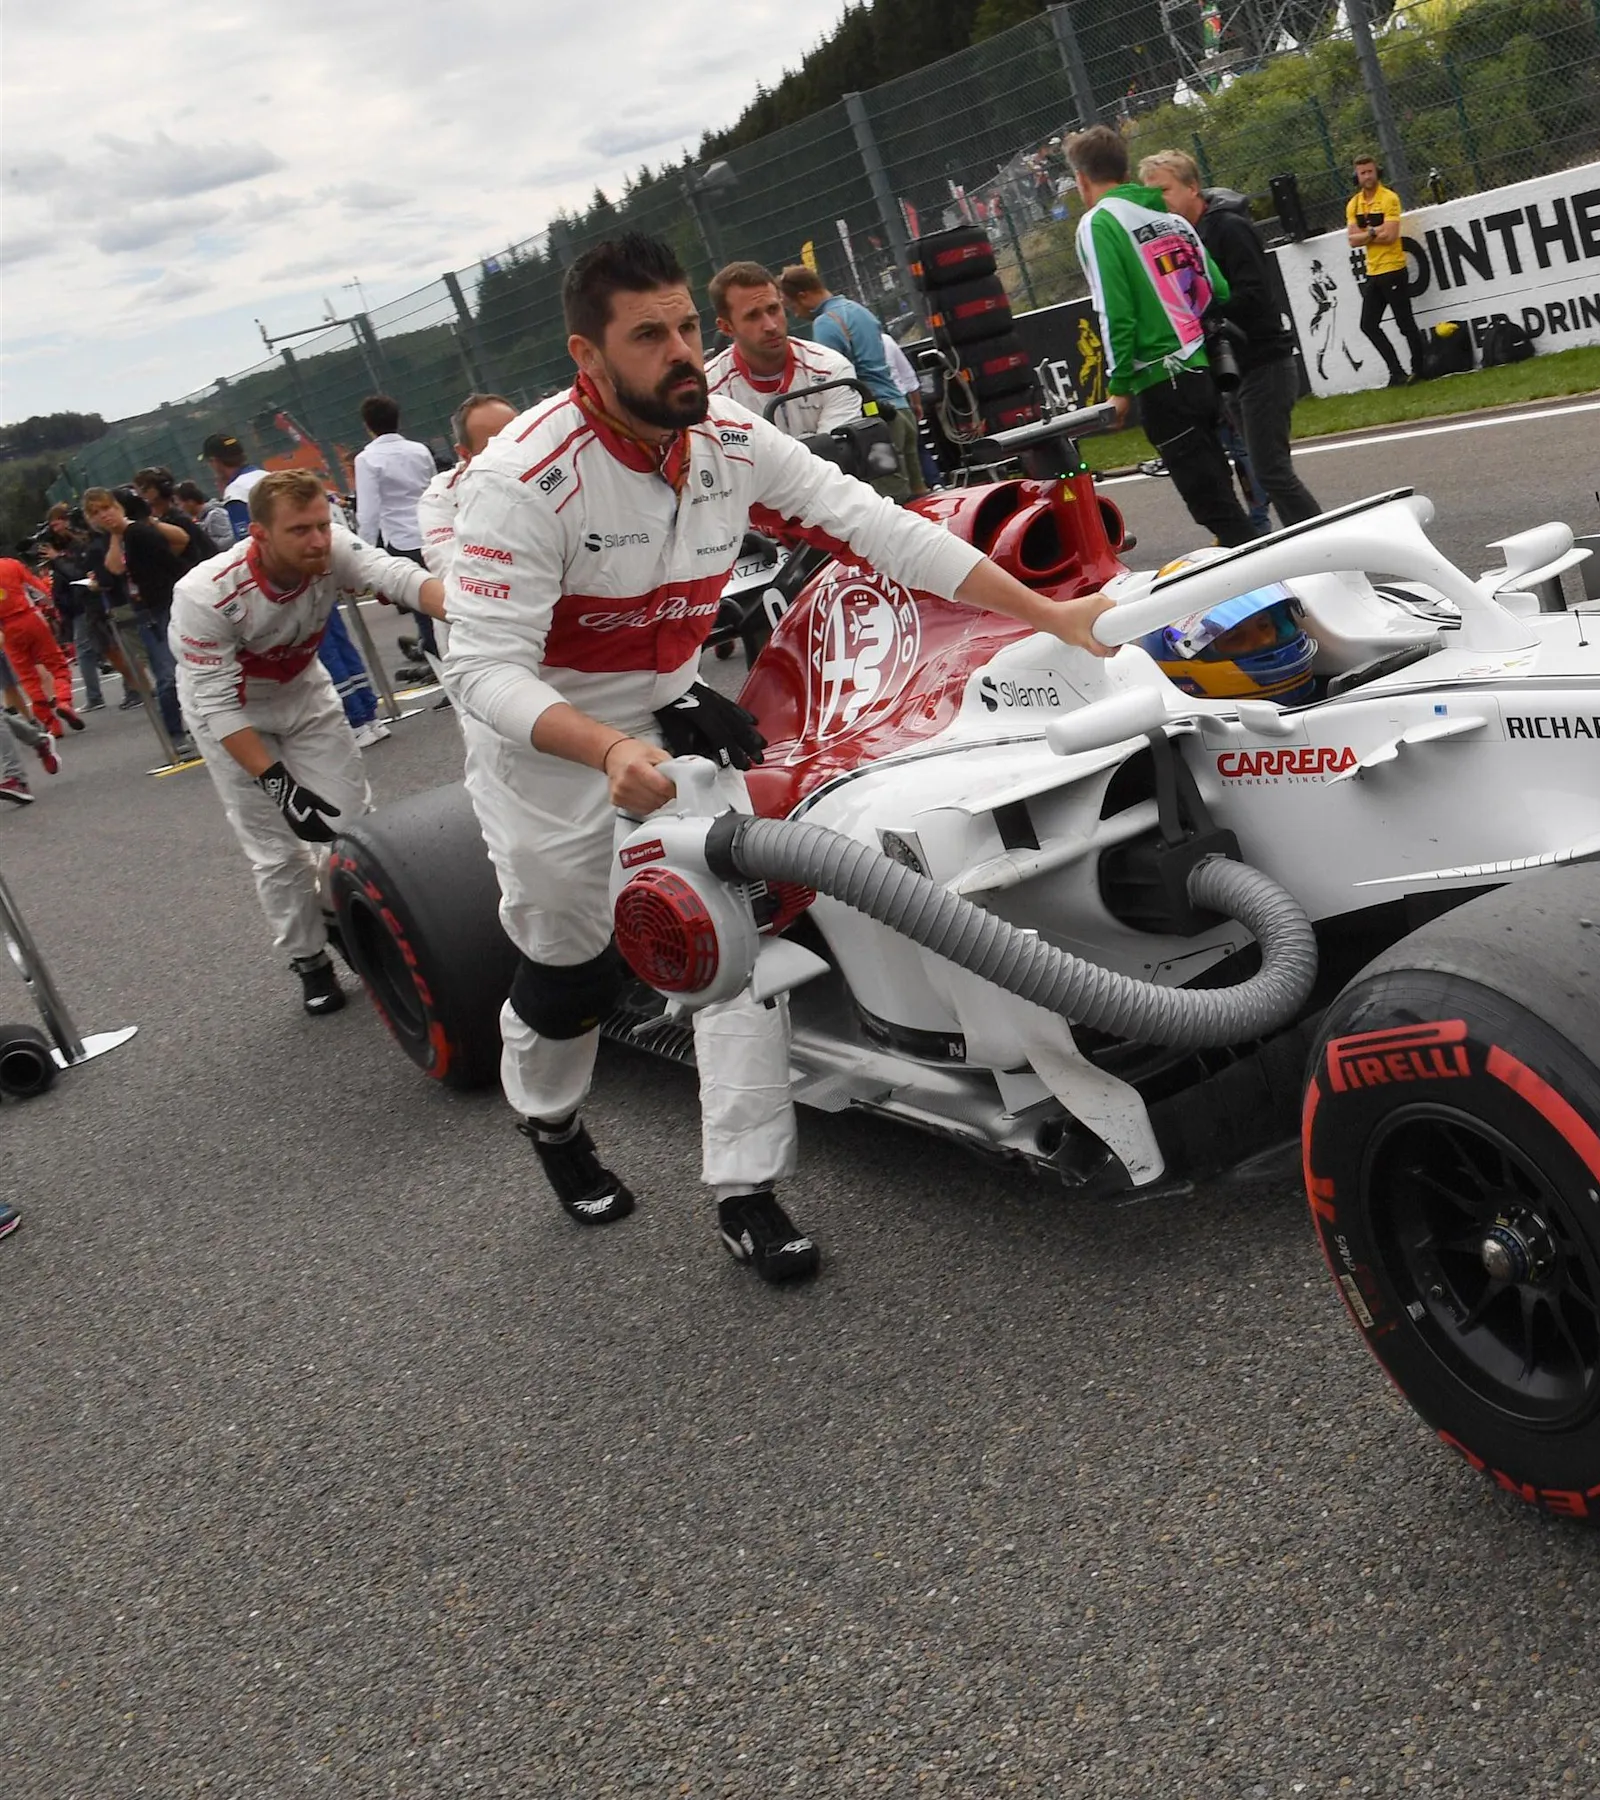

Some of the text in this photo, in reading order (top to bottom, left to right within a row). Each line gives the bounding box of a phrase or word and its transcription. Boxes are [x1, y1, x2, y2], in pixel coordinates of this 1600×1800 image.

[720, 431, 750, 446] OMP
[539, 468, 563, 491] OMP
[604, 531, 650, 548] Silanna
[463, 543, 513, 562] CARRERA
[1001, 682, 1063, 710] Silanna
[1217, 747, 1358, 777] CARRERA
[1221, 778, 1279, 787] EYEWEAR
[1288, 776, 1326, 784] SINCE
[1327, 1019, 1471, 1092] PIRELLI
